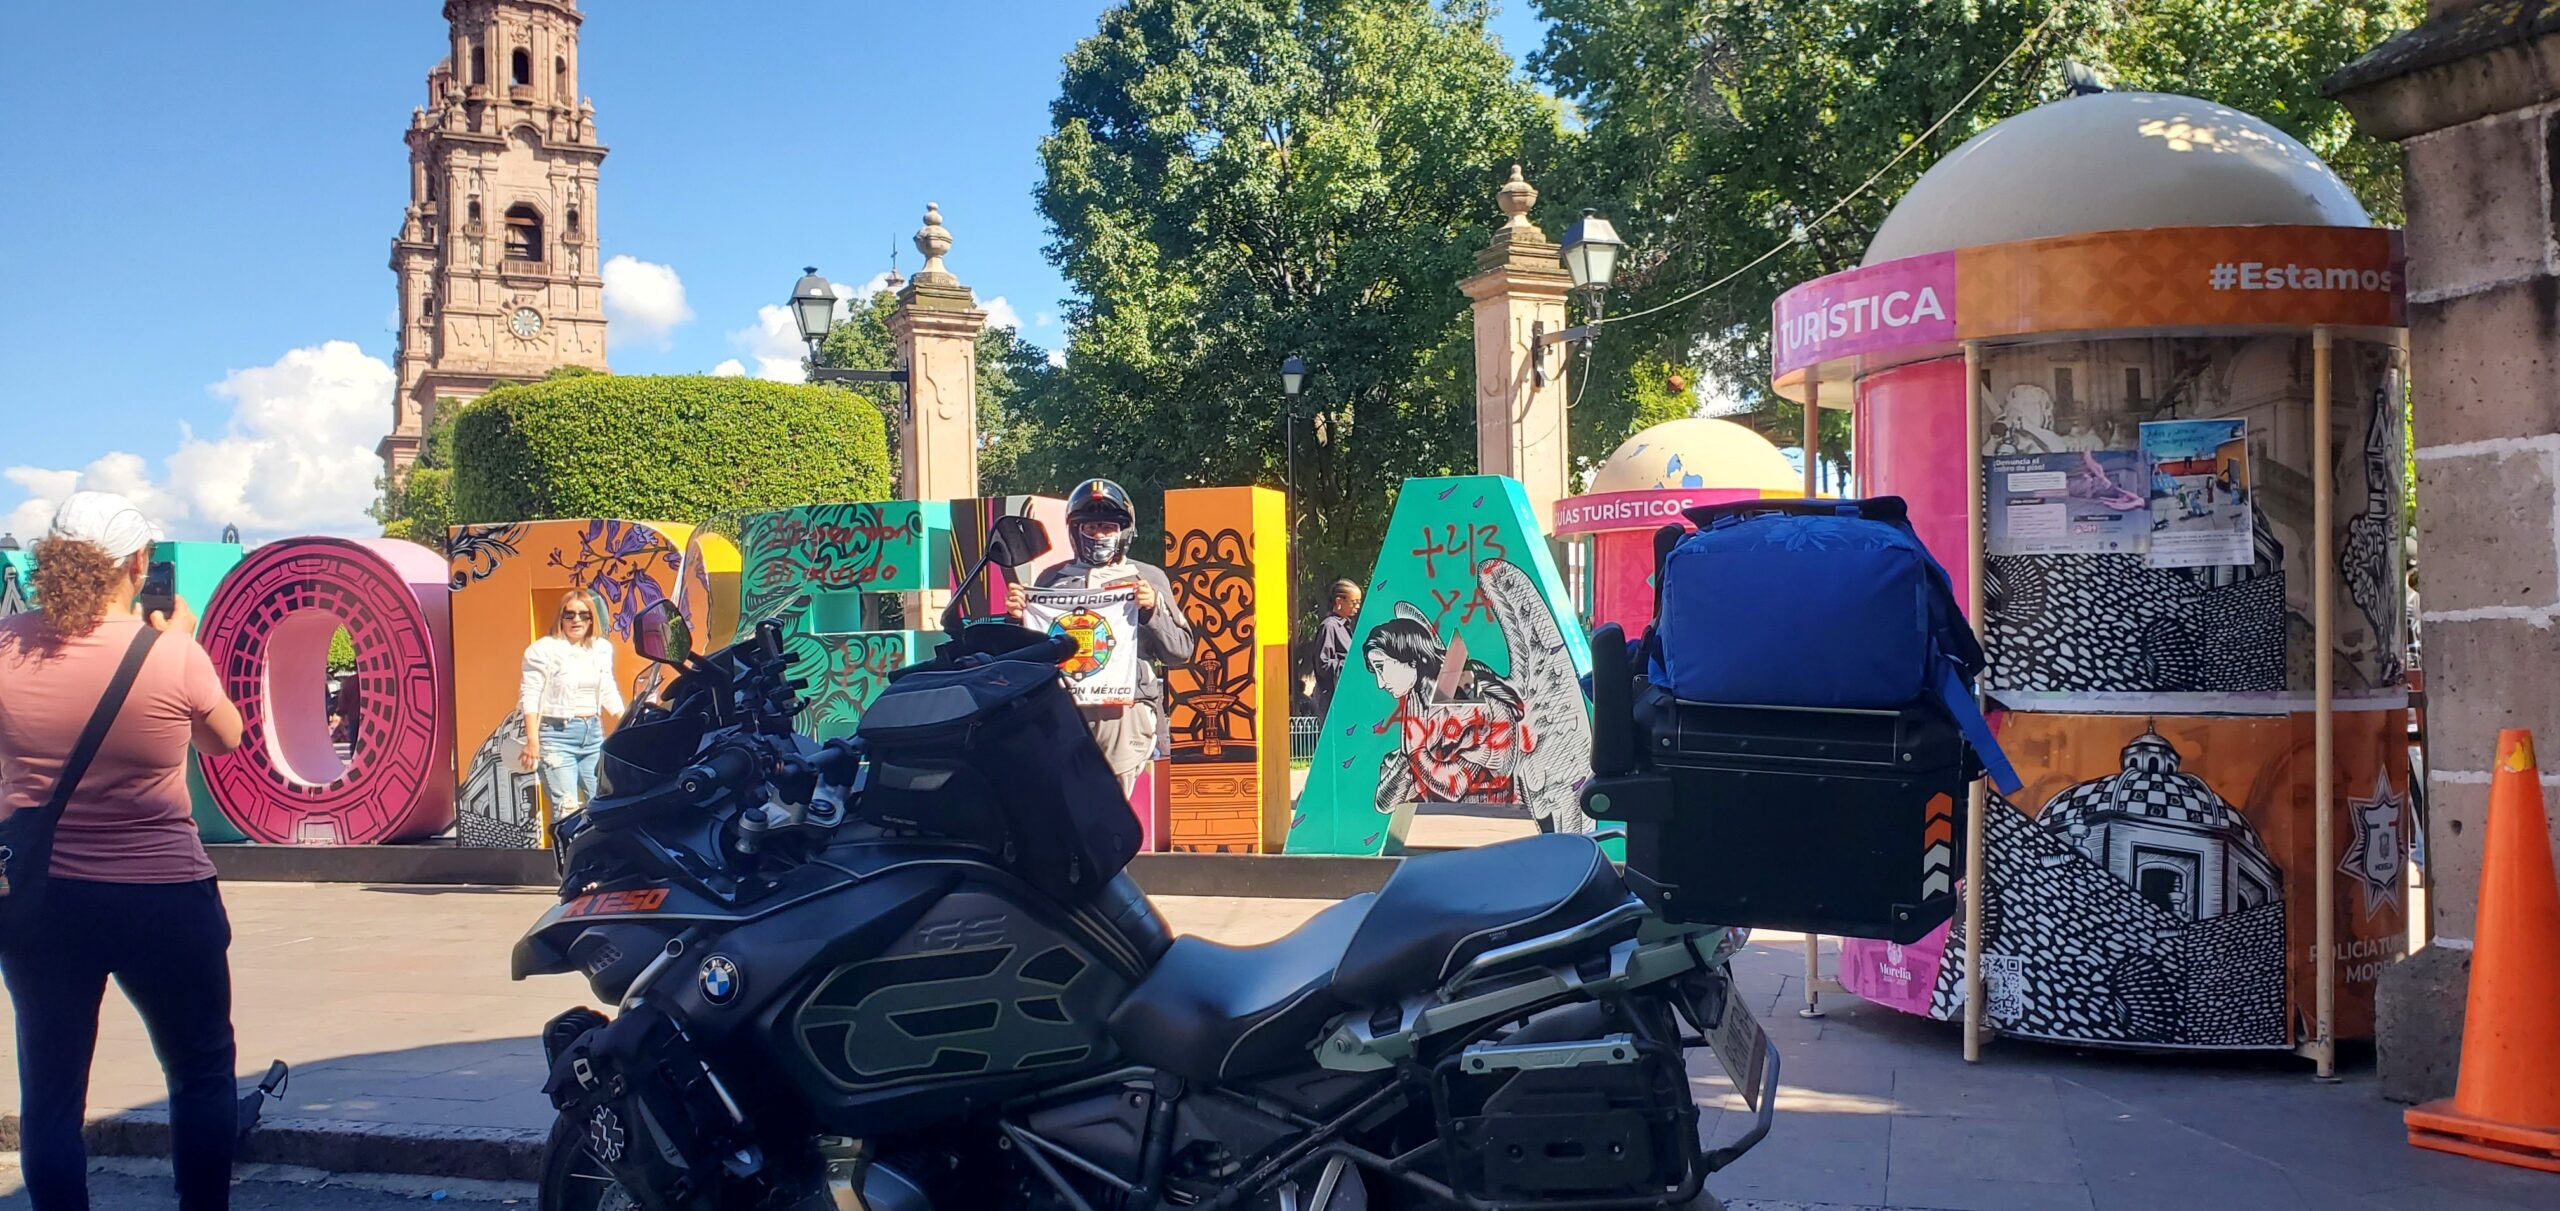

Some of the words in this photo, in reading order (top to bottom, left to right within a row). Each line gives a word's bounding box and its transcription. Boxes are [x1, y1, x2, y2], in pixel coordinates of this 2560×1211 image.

[1781, 286, 1946, 353] TURÍSTICA
[1555, 507, 1580, 527] UÍAS
[1025, 592, 1135, 606] MOTOTURISMO
[1091, 684, 1131, 695] MÉXICO
[591, 888, 670, 914] 1250
[1879, 962, 1911, 981] Morelia
